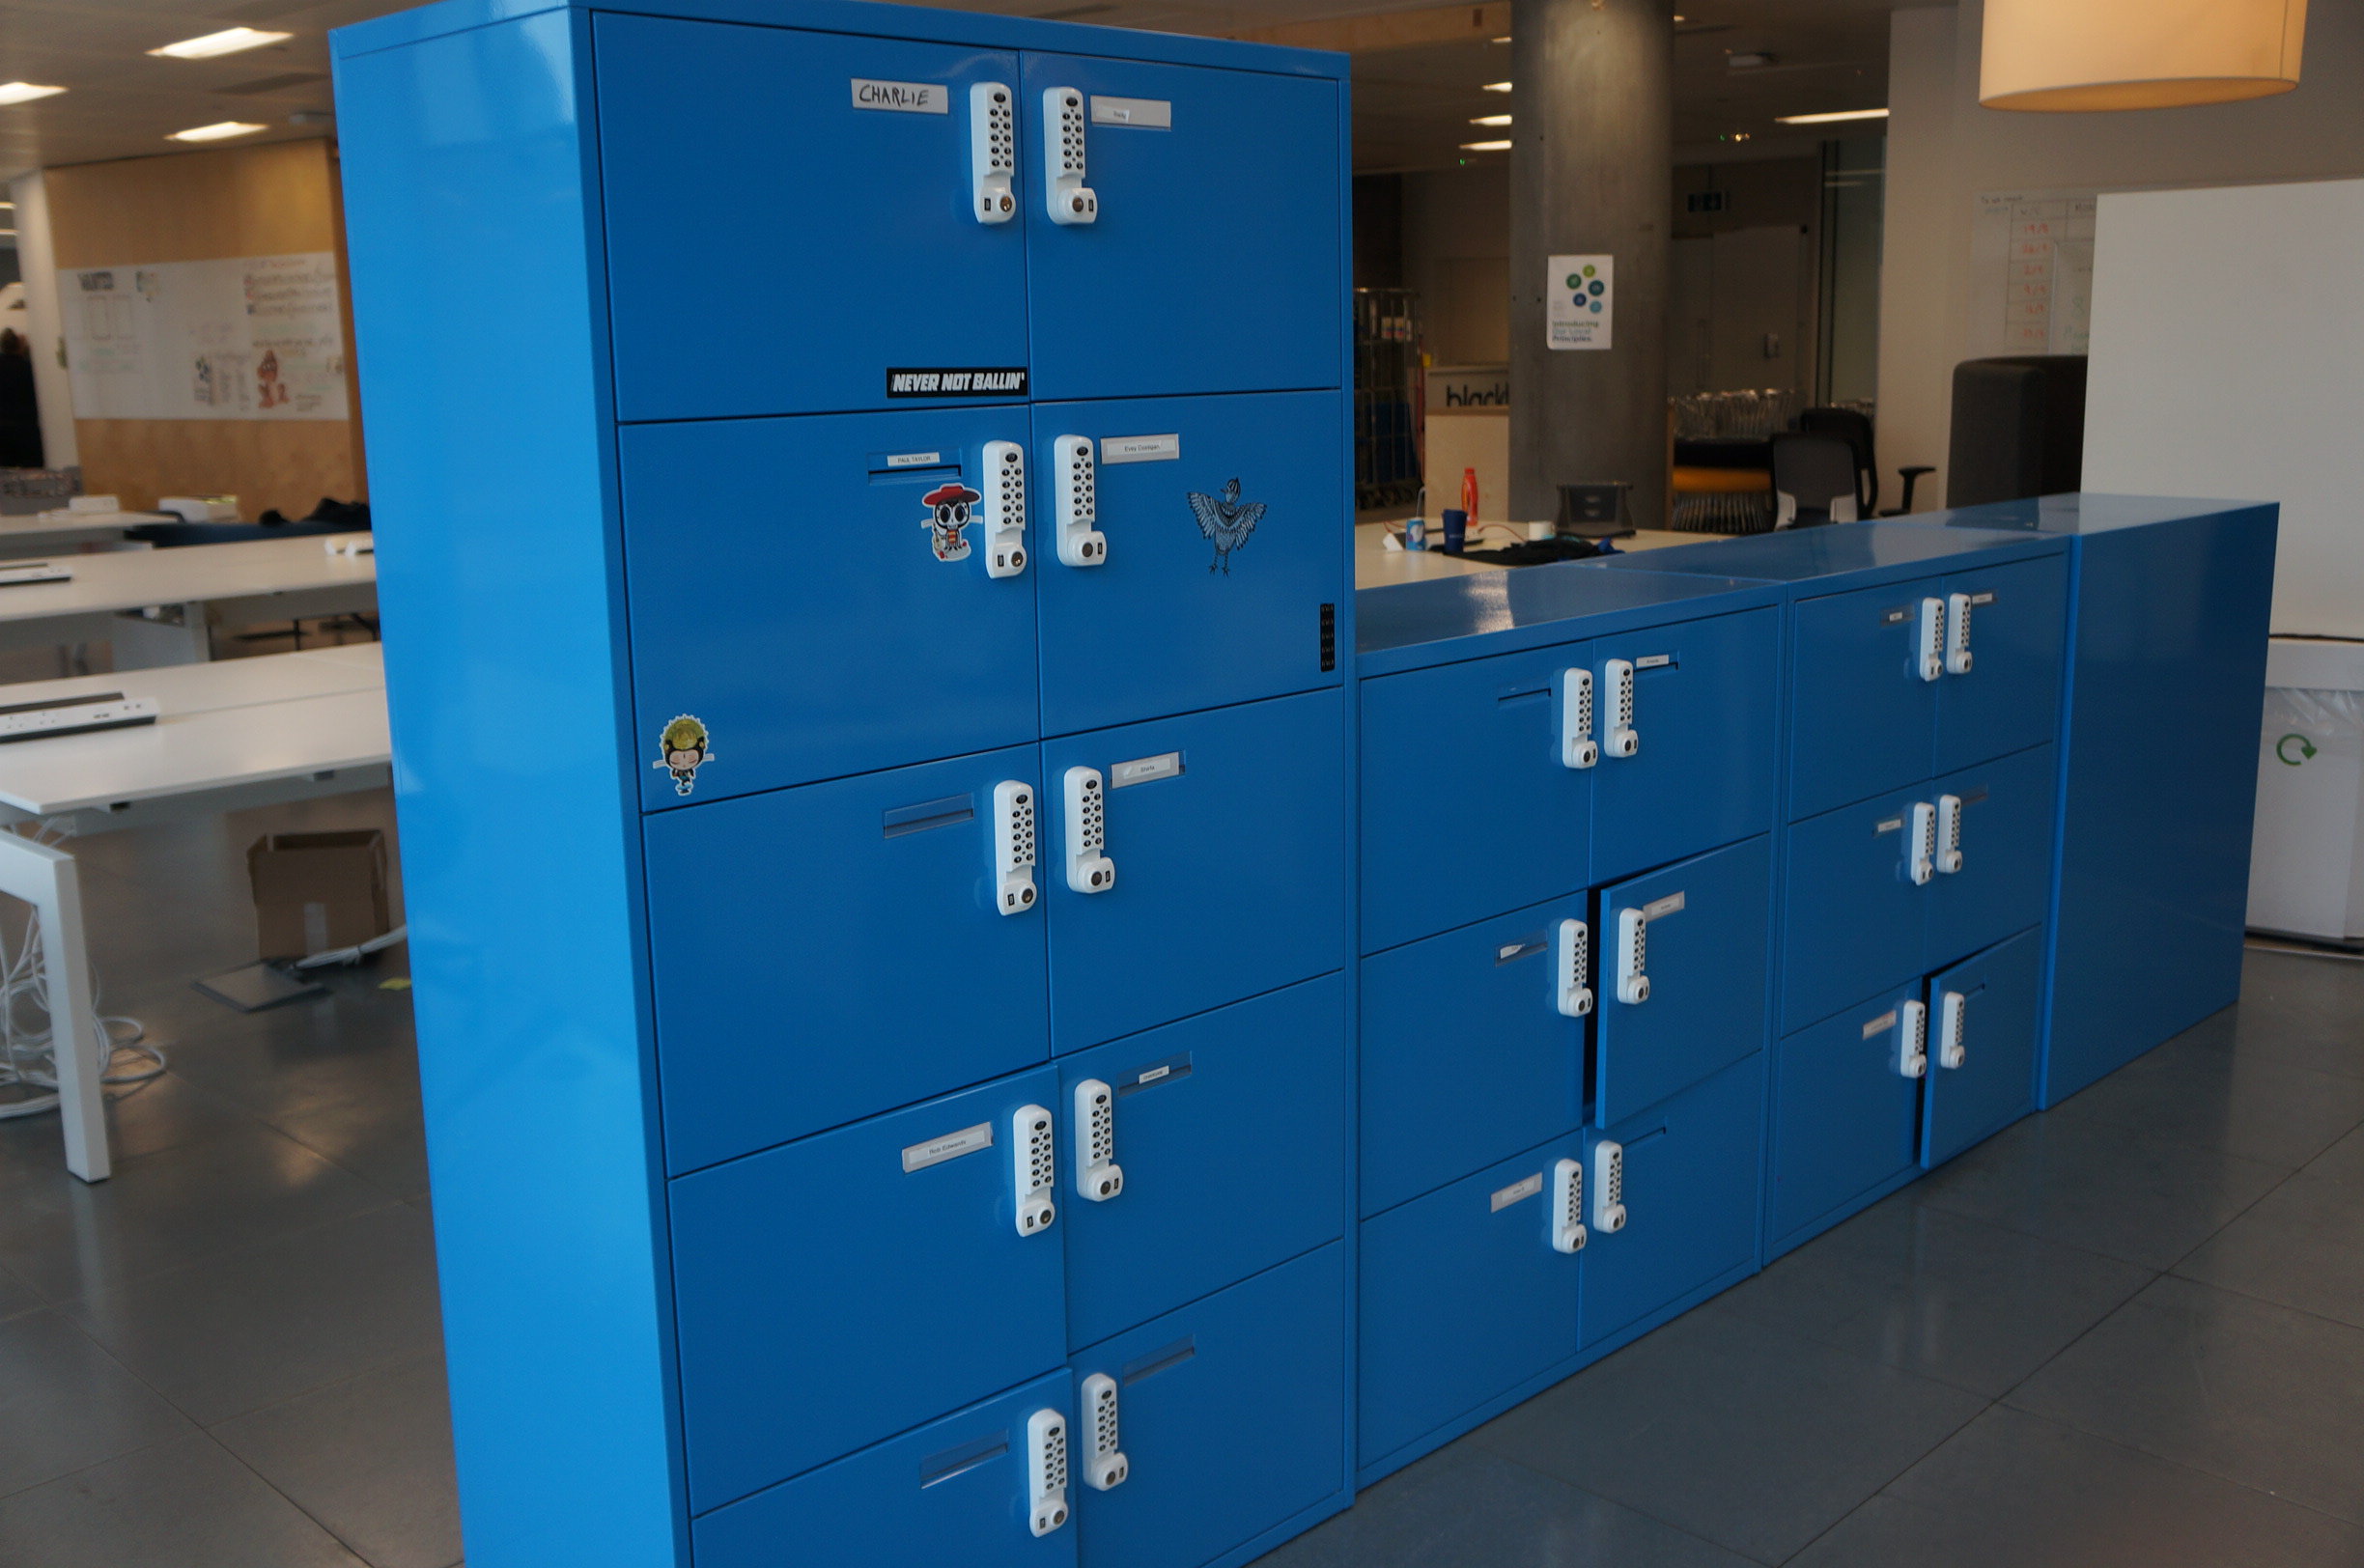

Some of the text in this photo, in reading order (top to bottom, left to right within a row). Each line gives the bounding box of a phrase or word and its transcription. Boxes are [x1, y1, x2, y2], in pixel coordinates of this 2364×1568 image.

[858, 84, 930, 107] CHARLIE
[892, 372, 1025, 392] NEVER NOT BALLIN'
